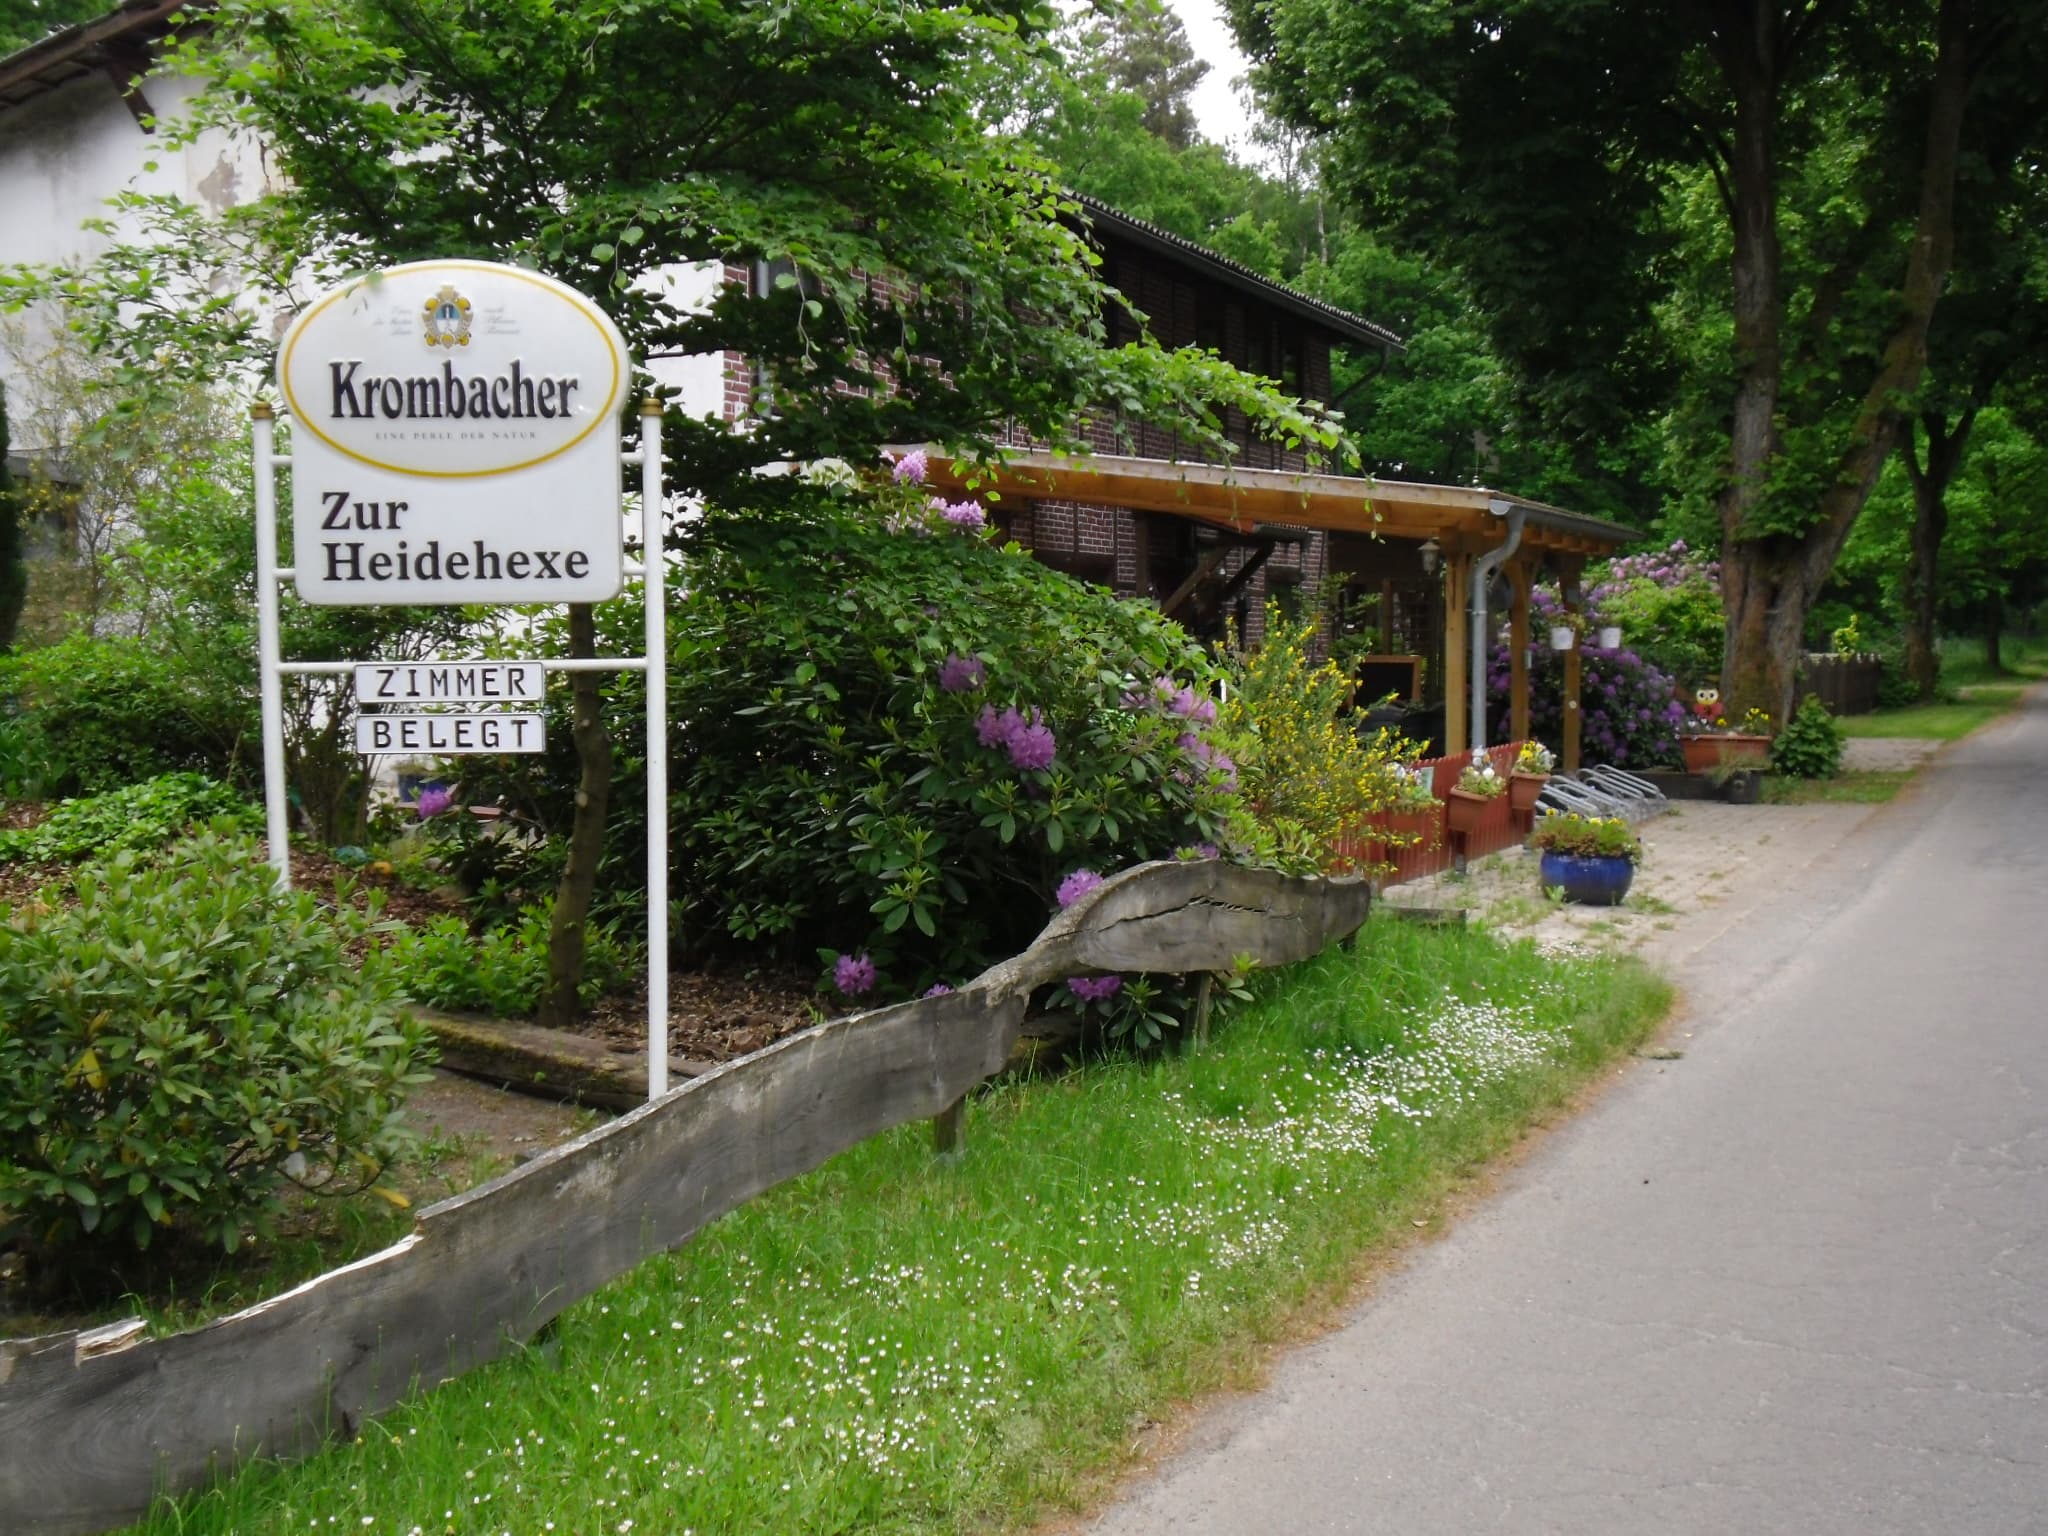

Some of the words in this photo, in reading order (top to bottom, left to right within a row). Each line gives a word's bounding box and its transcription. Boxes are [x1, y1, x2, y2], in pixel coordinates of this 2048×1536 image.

[329, 359, 578, 419] Krombacher
[321, 491, 408, 530] Zur
[322, 541, 590, 580] Heidehexe
[376, 668, 526, 697] ZIMMER
[373, 720, 528, 748] BELEGT
